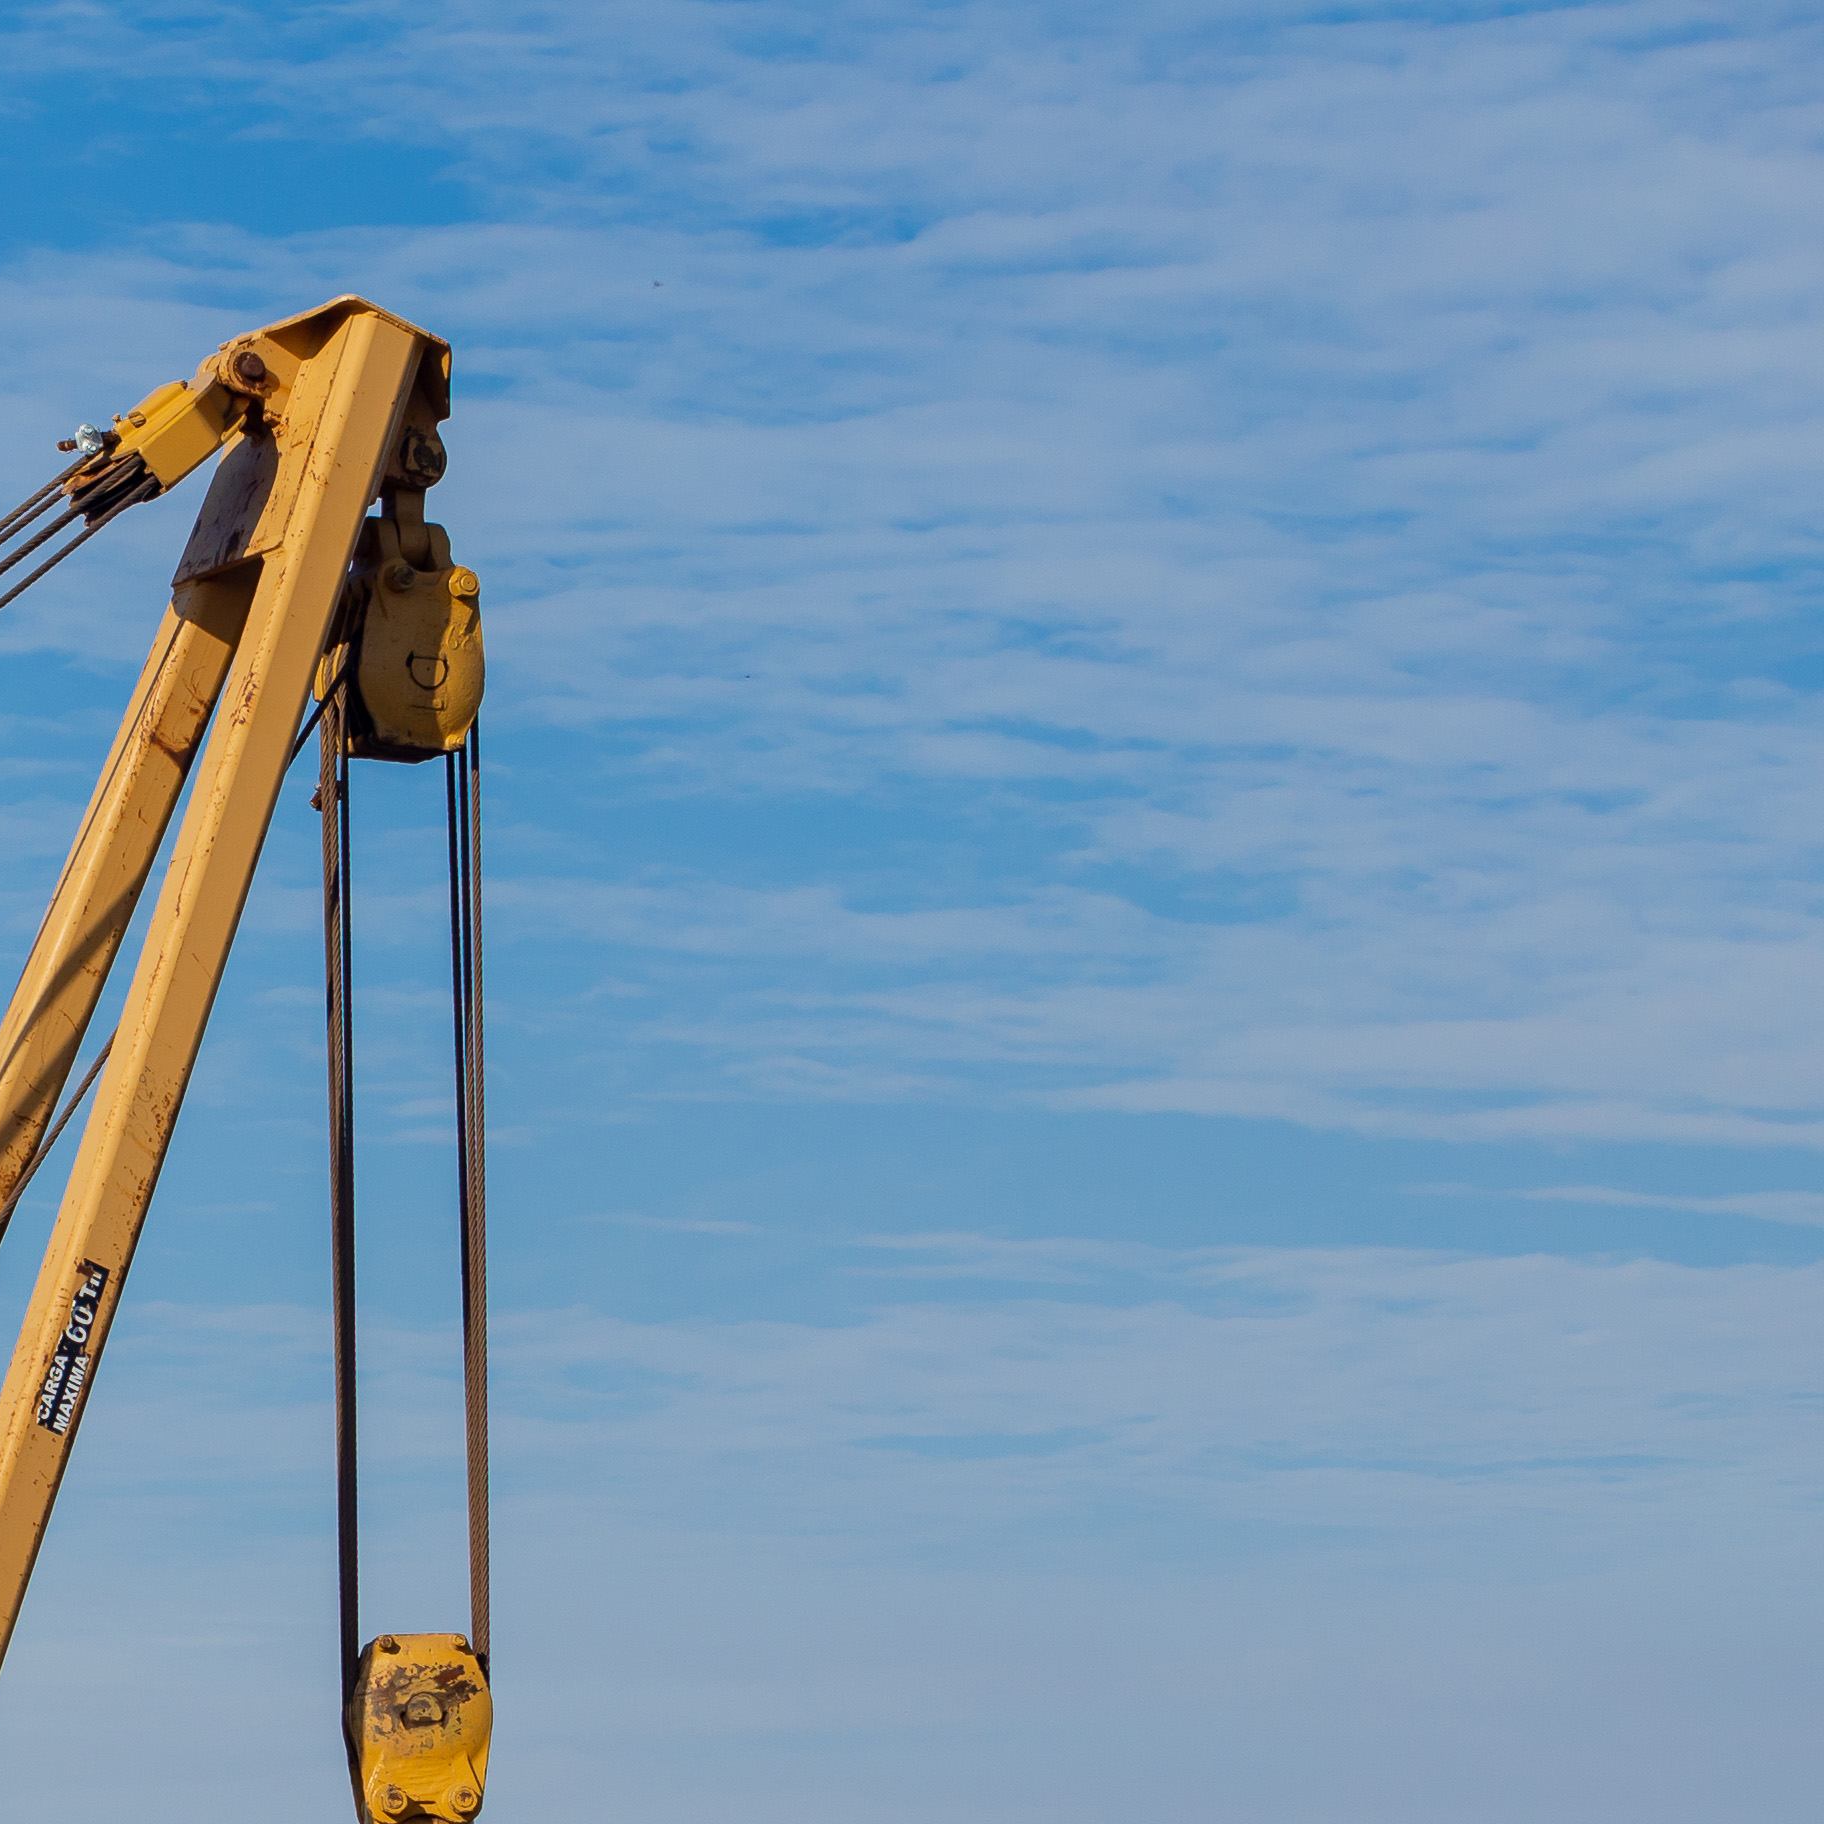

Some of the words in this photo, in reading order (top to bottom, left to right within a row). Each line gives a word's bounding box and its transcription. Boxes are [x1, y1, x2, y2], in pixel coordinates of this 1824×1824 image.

[66, 1305, 94, 1344] 60
[37, 1354, 69, 1420] CARGA
[52, 1355, 90, 1433] MAXIMA
